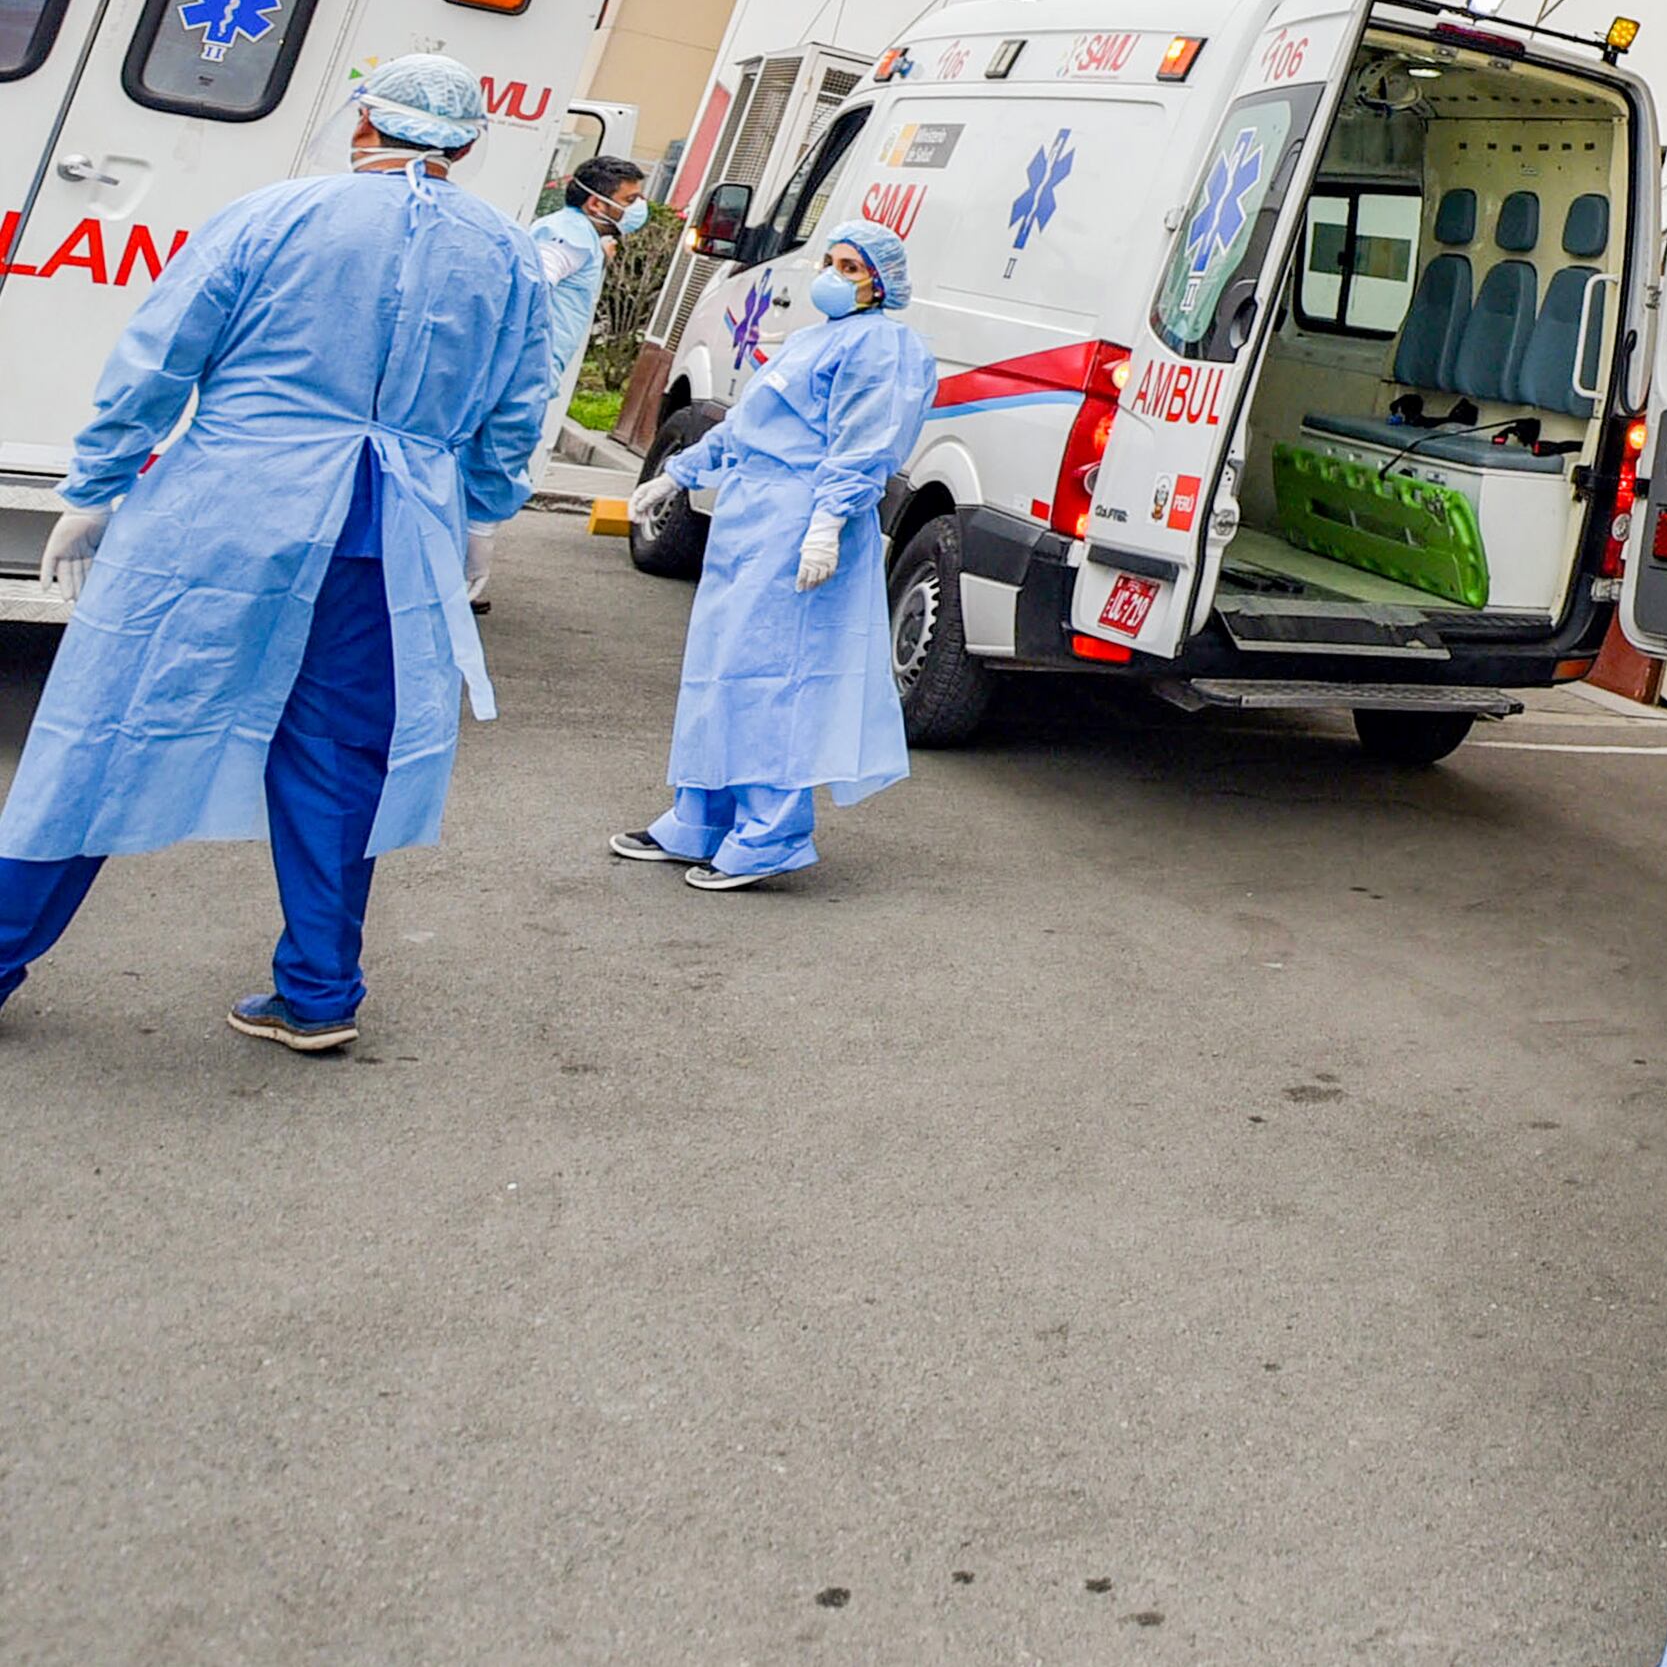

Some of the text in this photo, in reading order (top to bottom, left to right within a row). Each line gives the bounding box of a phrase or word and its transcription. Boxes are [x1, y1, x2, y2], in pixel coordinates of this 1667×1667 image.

[1076, 33, 1142, 72] SAMU
[862, 182, 928, 242] SAMU
[1131, 359, 1224, 426] AMBUL
